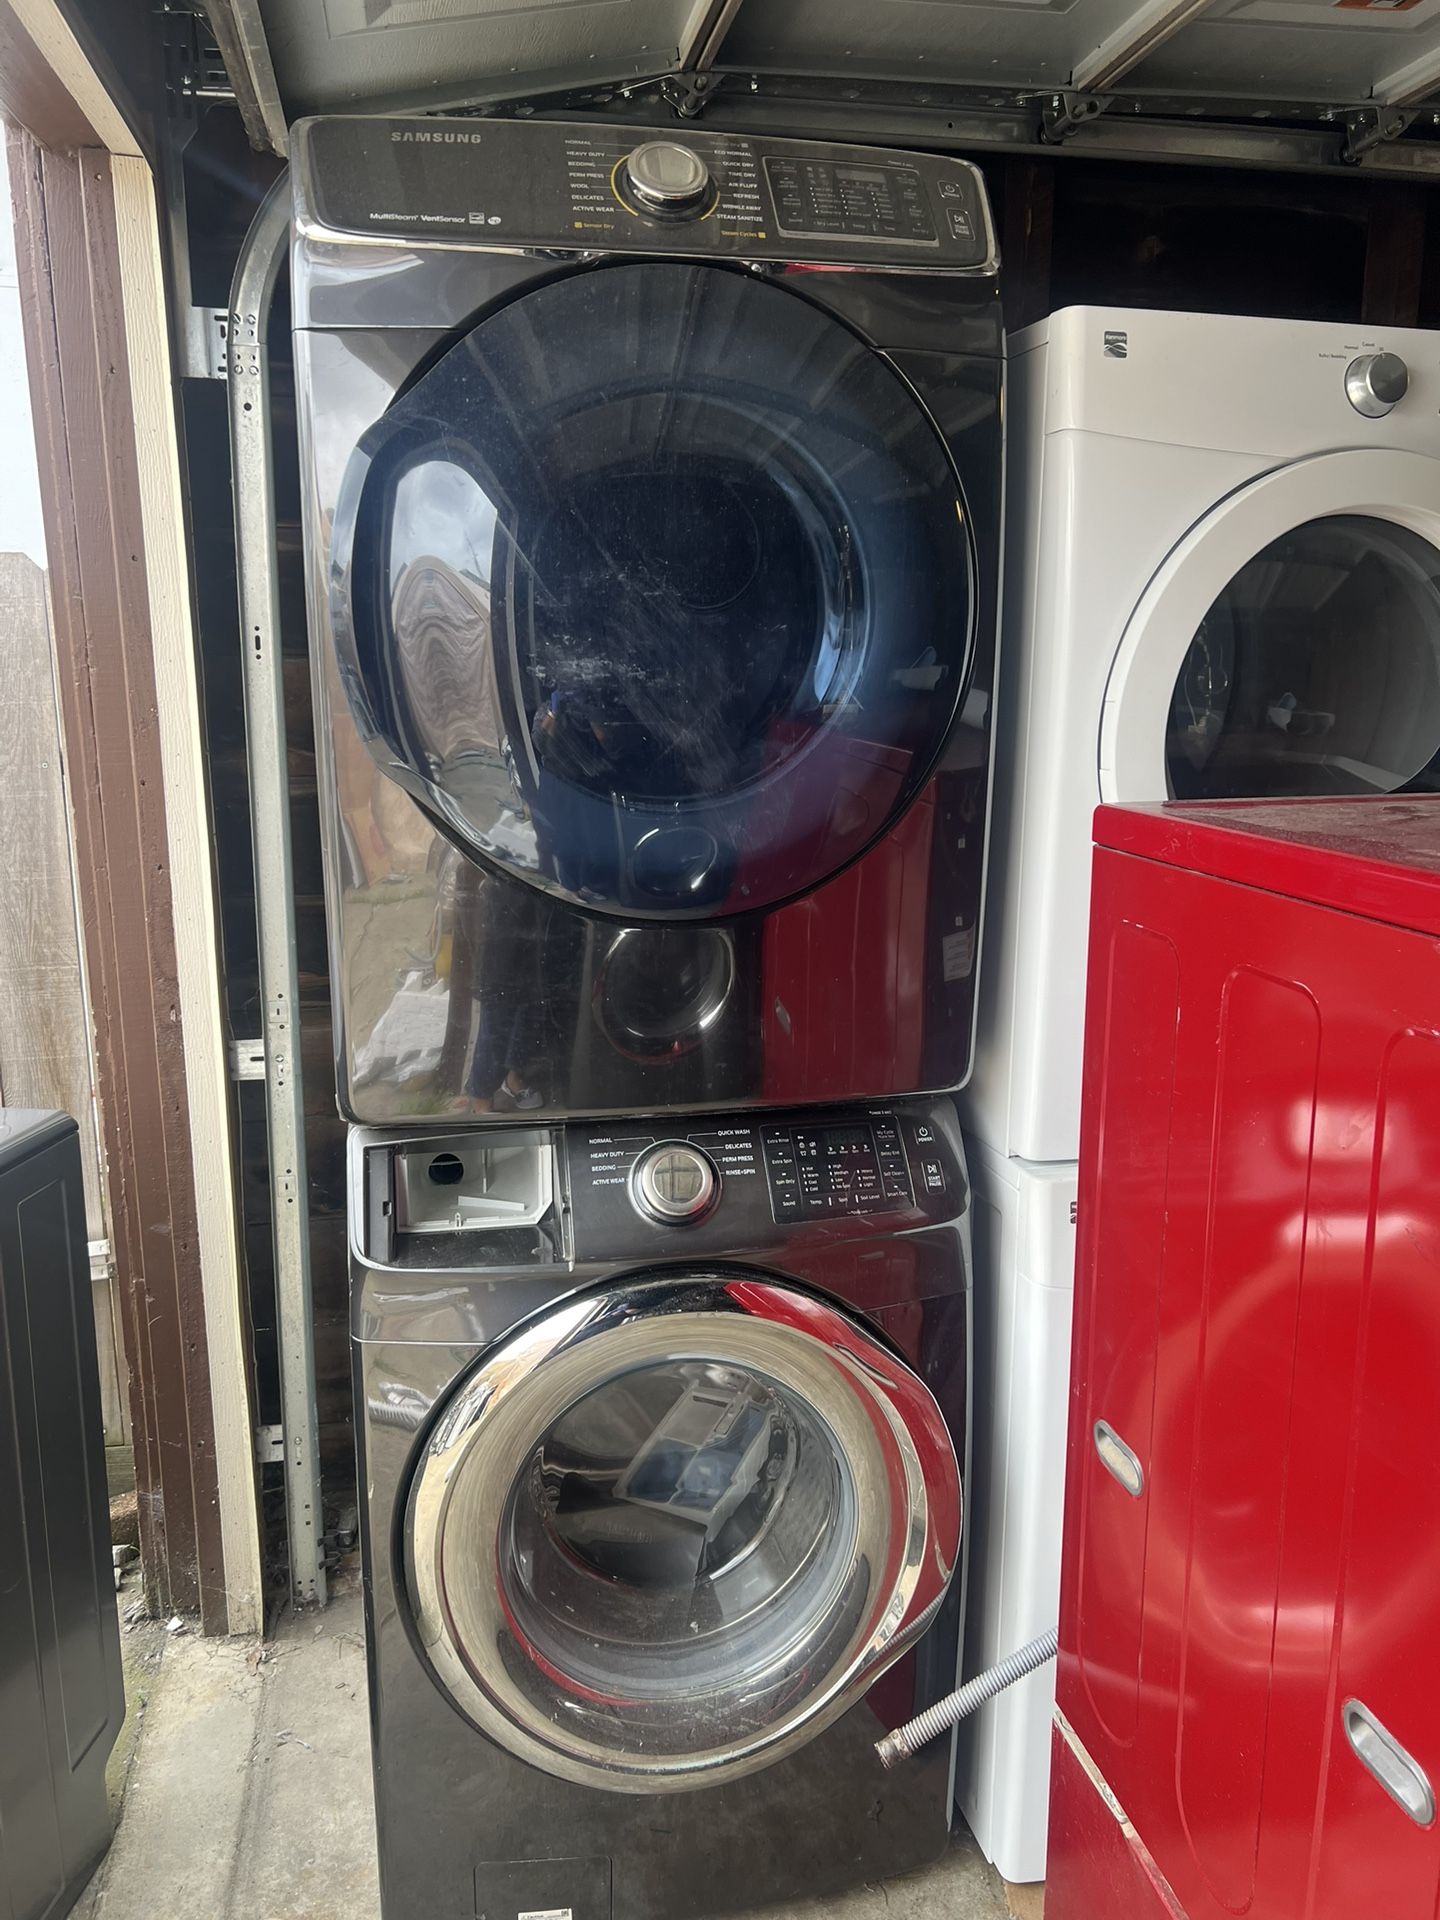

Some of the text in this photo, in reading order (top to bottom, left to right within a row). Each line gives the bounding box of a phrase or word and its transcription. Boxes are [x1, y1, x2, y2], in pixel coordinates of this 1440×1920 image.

[391, 132, 481, 144] SAMSUNG
[420, 214, 466, 224] VentSensor
[724, 1142, 752, 1150] DELICATES
[591, 1164, 617, 1172] BEDDING
[725, 1168, 756, 1176] RINSE+SPIN
